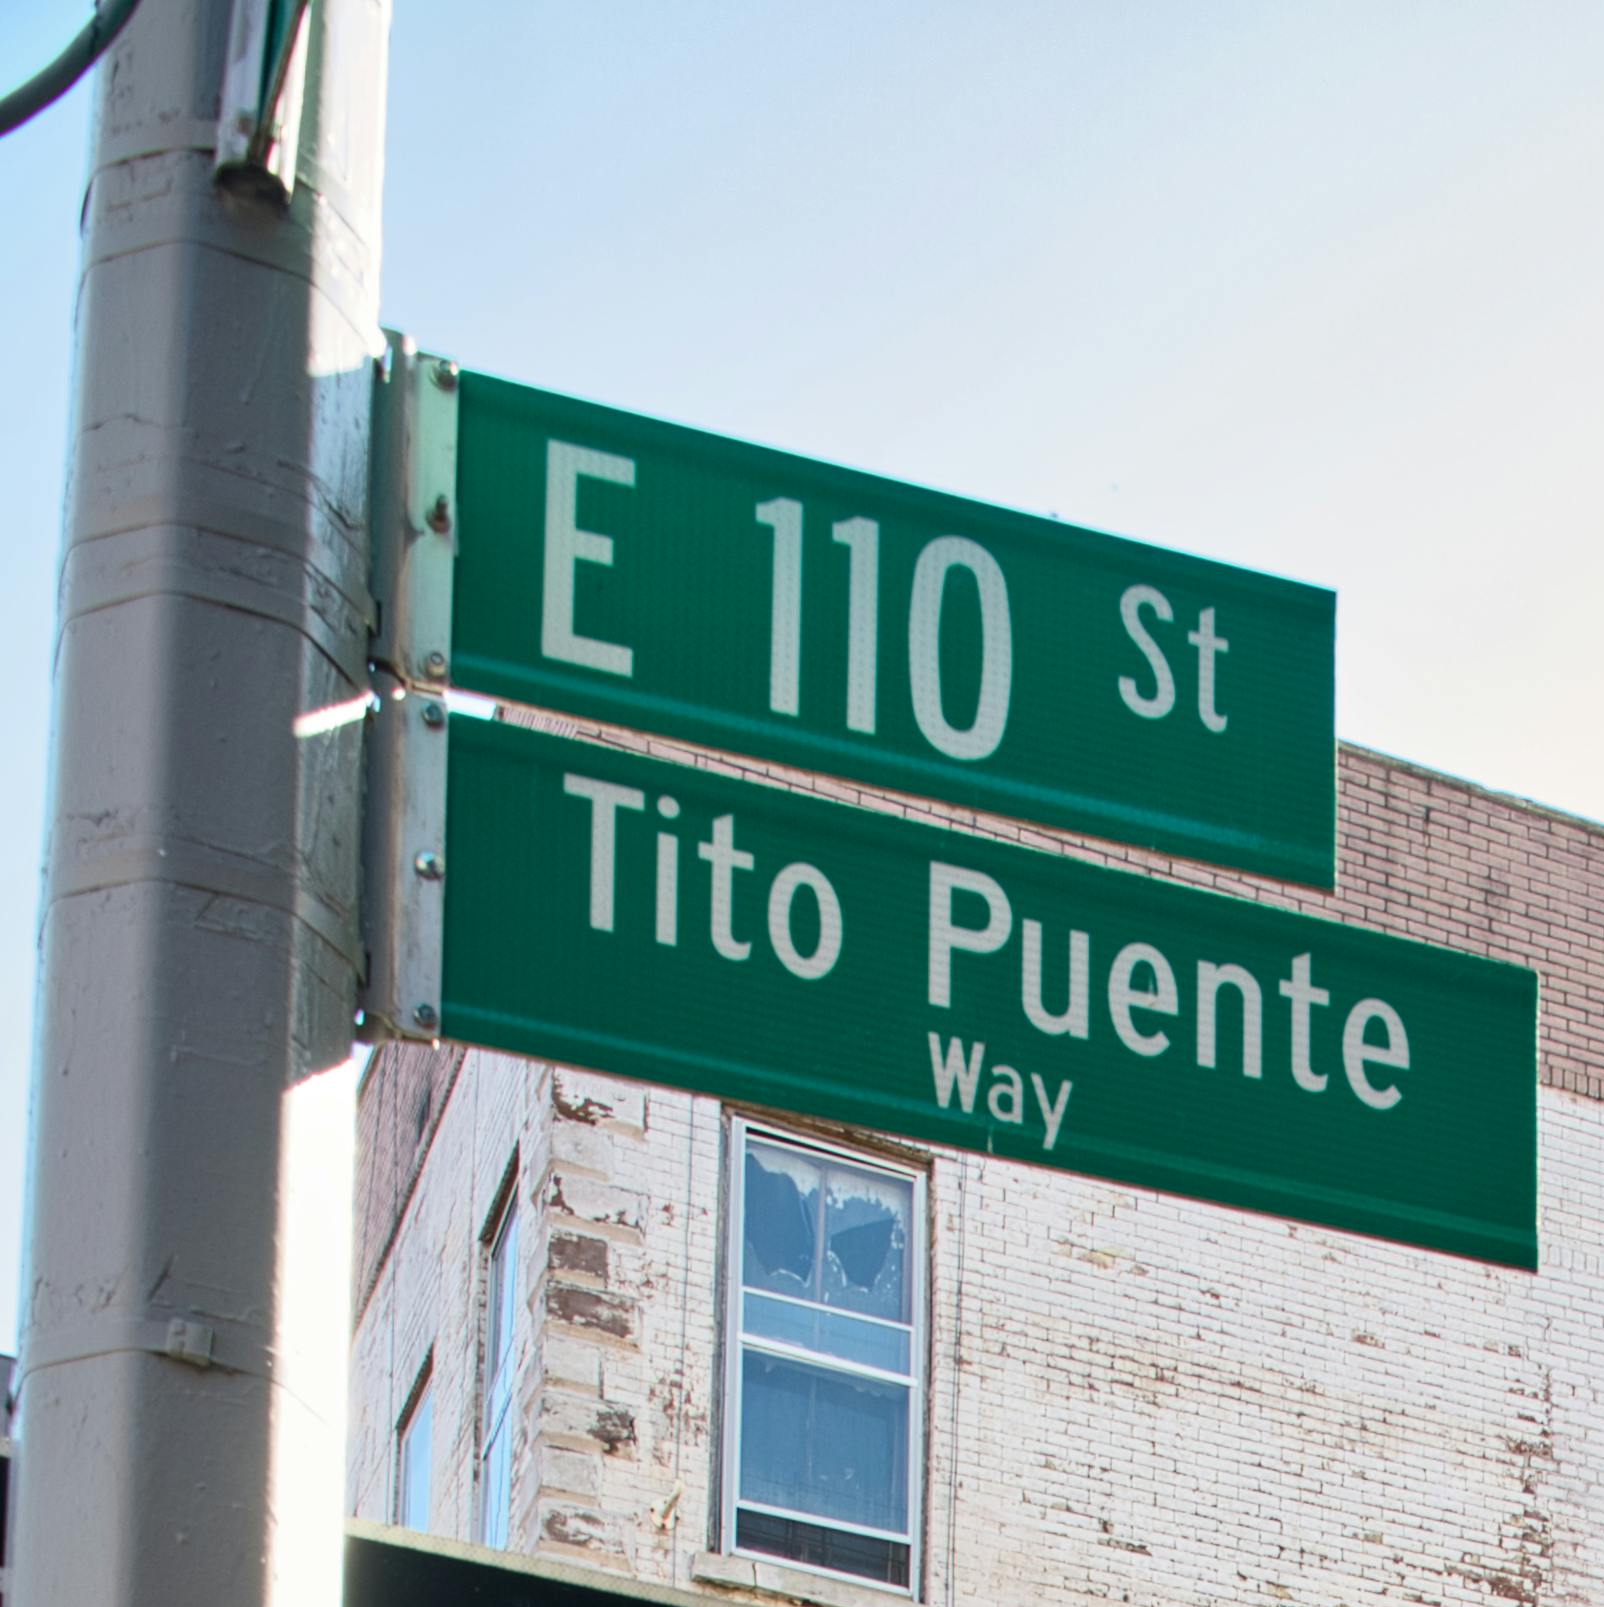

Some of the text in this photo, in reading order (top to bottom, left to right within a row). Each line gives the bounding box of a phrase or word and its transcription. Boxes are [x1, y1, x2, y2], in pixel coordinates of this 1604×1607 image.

[541, 438, 1231, 763] E 110 St
[562, 772, 1412, 1111] Tito Puente
[927, 1032, 1073, 1151] Way
